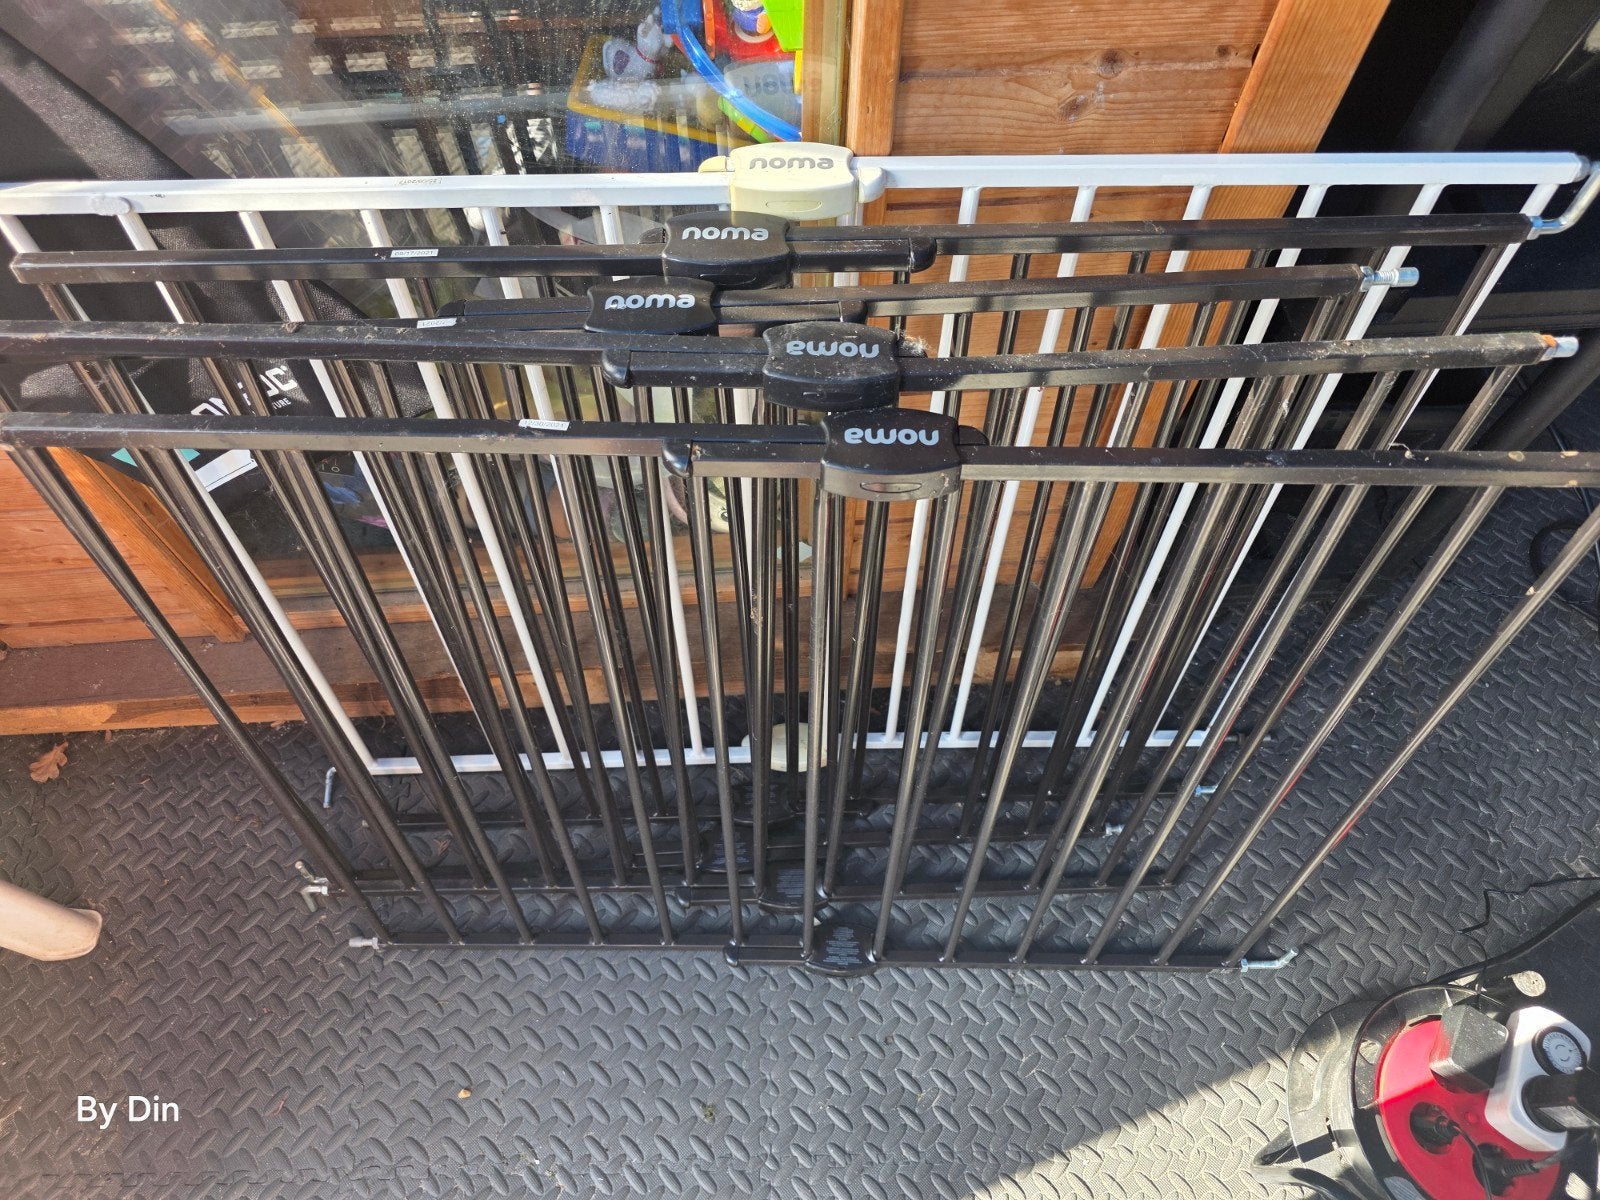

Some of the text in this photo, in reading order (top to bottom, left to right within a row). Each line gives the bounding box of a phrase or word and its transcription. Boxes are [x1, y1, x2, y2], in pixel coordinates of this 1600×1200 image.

[749, 156, 834, 170] noma
[681, 226, 769, 241] noma
[604, 293, 695, 310] noma
[786, 340, 880, 359] noma
[844, 427, 940, 446] noma
